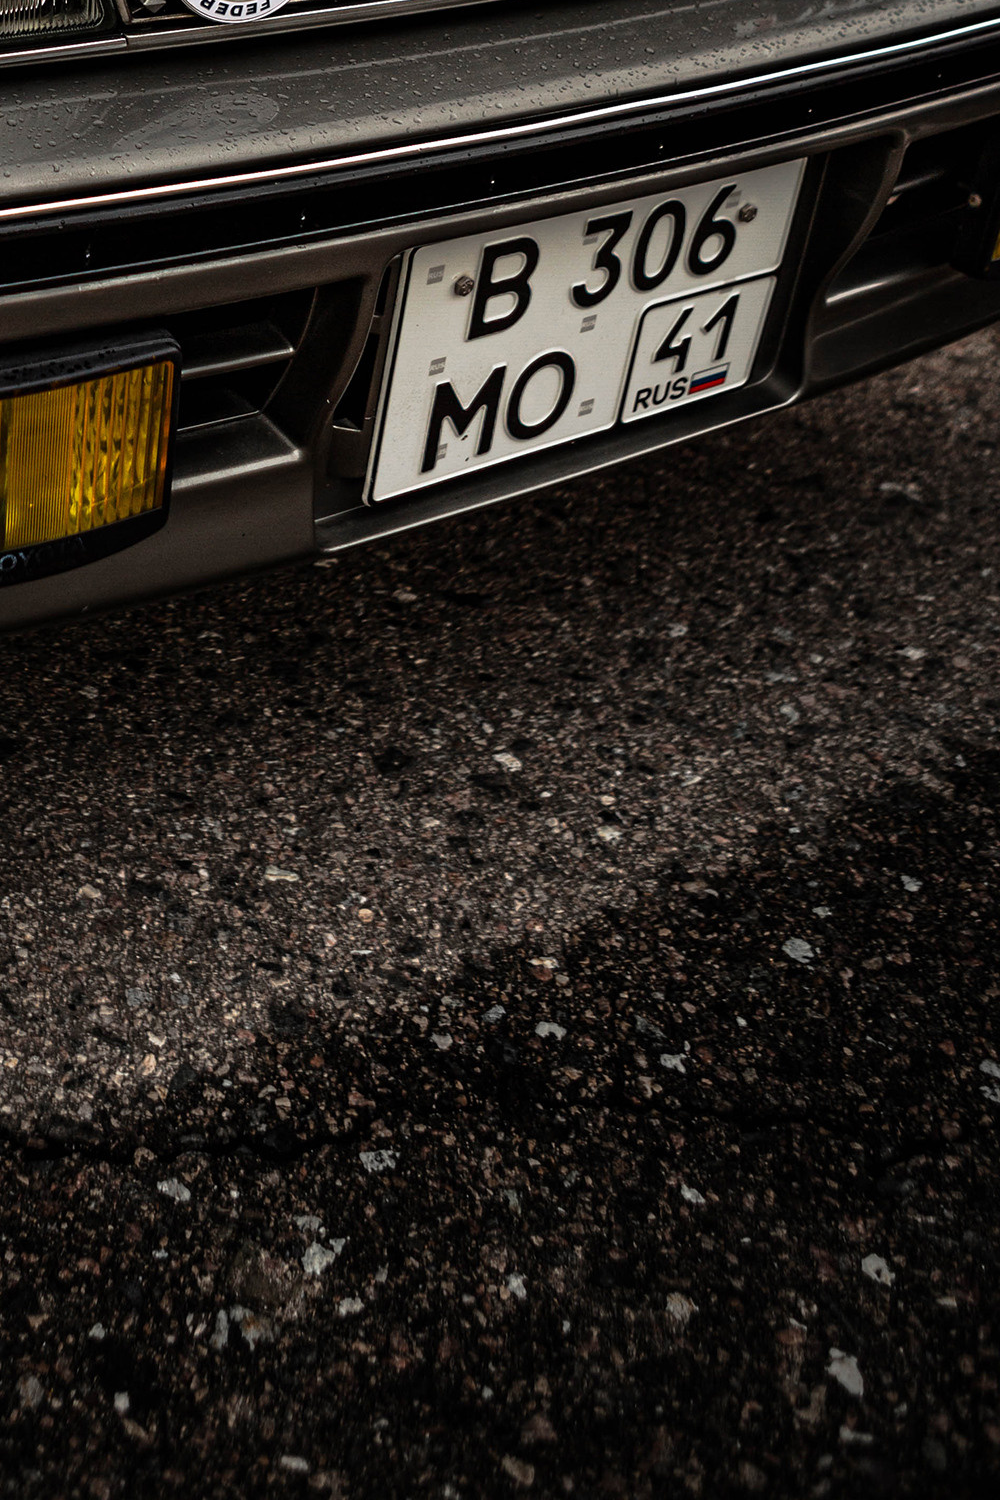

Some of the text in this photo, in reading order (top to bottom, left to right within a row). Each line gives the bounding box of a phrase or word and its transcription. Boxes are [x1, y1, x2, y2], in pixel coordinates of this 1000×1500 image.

[465, 183, 738, 342] B 306
[652, 292, 740, 373] 41
[419, 350, 577, 474] MO
[632, 376, 689, 413] RUS
